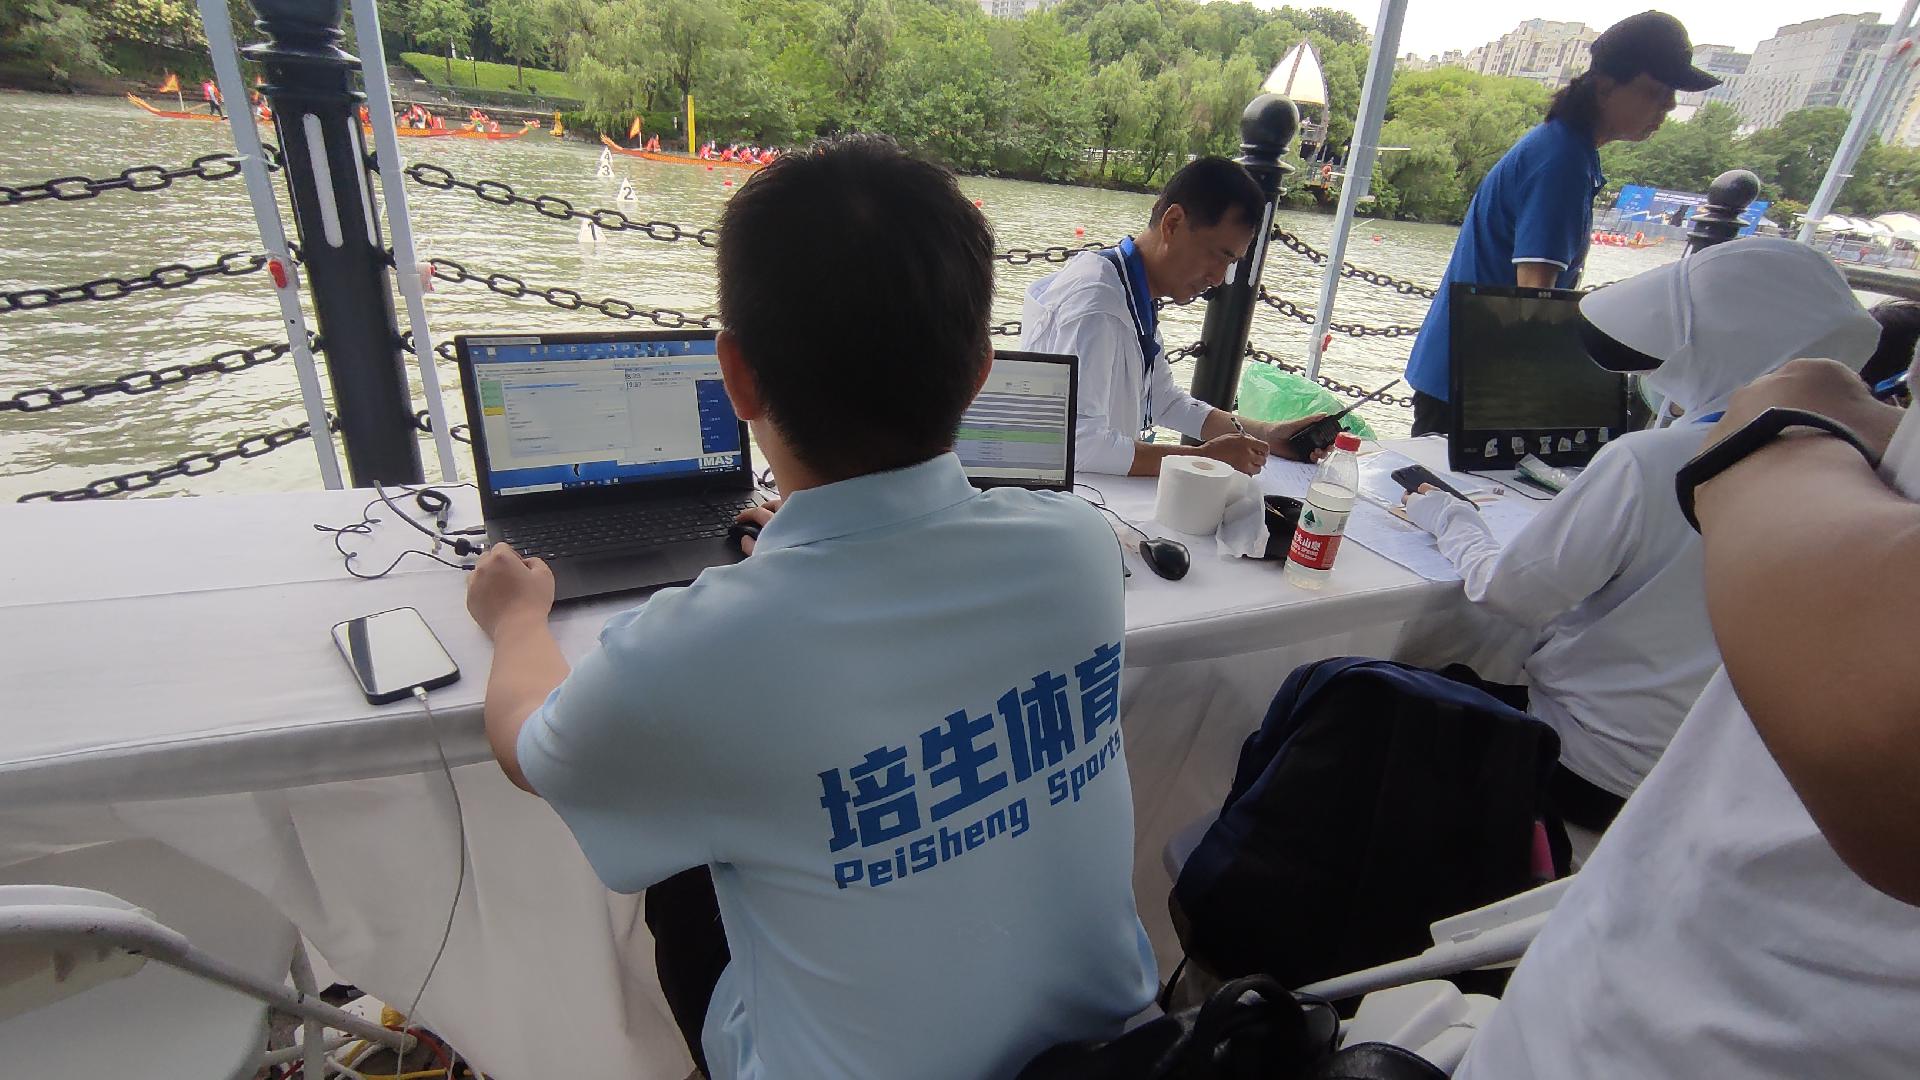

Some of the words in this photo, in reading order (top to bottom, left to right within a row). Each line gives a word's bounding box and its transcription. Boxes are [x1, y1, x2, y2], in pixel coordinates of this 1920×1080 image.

[601, 165, 610, 176] 3
[623, 186, 633, 200] 2
[587, 221, 597, 240] 1
[816, 641, 1122, 853] 培生体育
[833, 797, 1031, 890] PeiSheng
[1046, 728, 1121, 806] Sports
